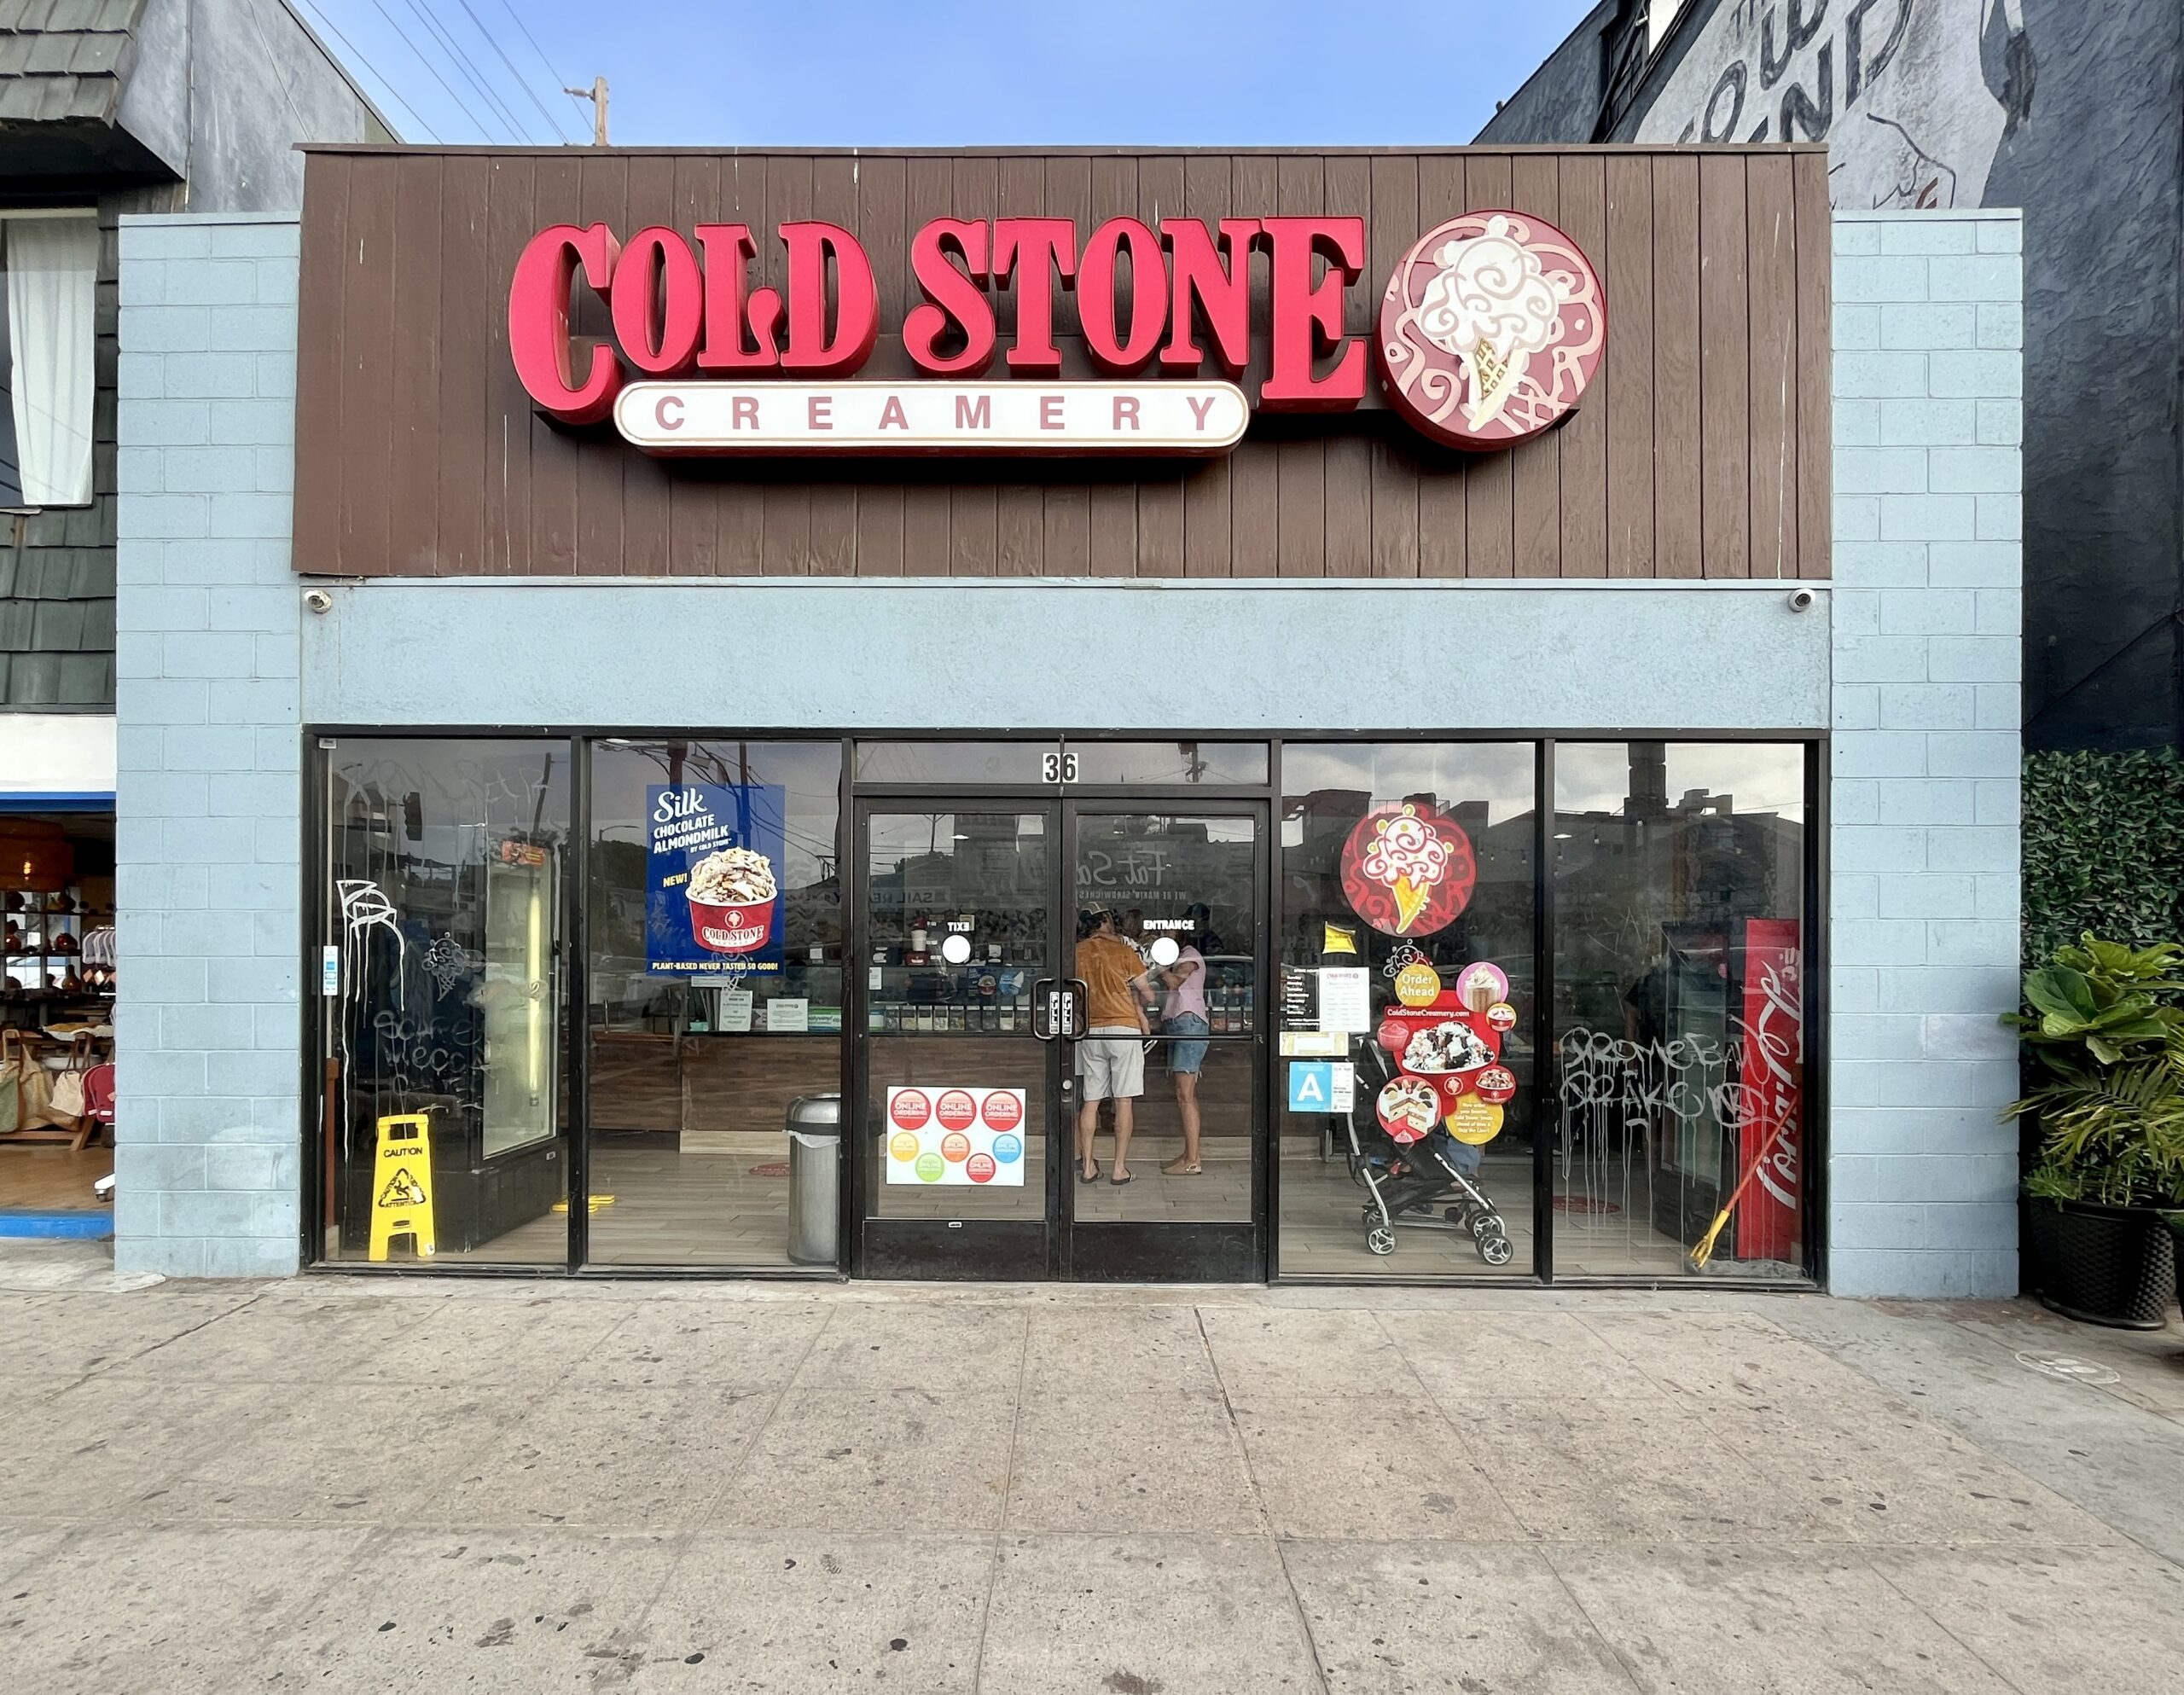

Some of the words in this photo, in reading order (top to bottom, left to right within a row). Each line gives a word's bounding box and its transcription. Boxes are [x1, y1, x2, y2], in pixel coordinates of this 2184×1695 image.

[508, 221, 879, 416] COLD
[903, 215, 1367, 401] STONE
[654, 395, 1217, 431] CREAMERY
[1045, 754, 1076, 781] 36
[653, 788, 708, 822] Silk
[653, 814, 715, 839] CHOCOLATE
[653, 825, 729, 854] ALMONDMILK
[698, 843, 712, 851] COLD
[663, 873, 688, 887] NEW!
[1143, 920, 1194, 931] ENTRANCE
[703, 927, 729, 941] COLD
[730, 926, 764, 941] STONE
[1402, 973, 1433, 984] Order
[1399, 986, 1436, 996] Ahead
[1387, 1008, 1470, 1019] ColdStoneCreamery.com
[1297, 1072, 1324, 1102] A
[384, 1147, 422, 1158] CAUTION
